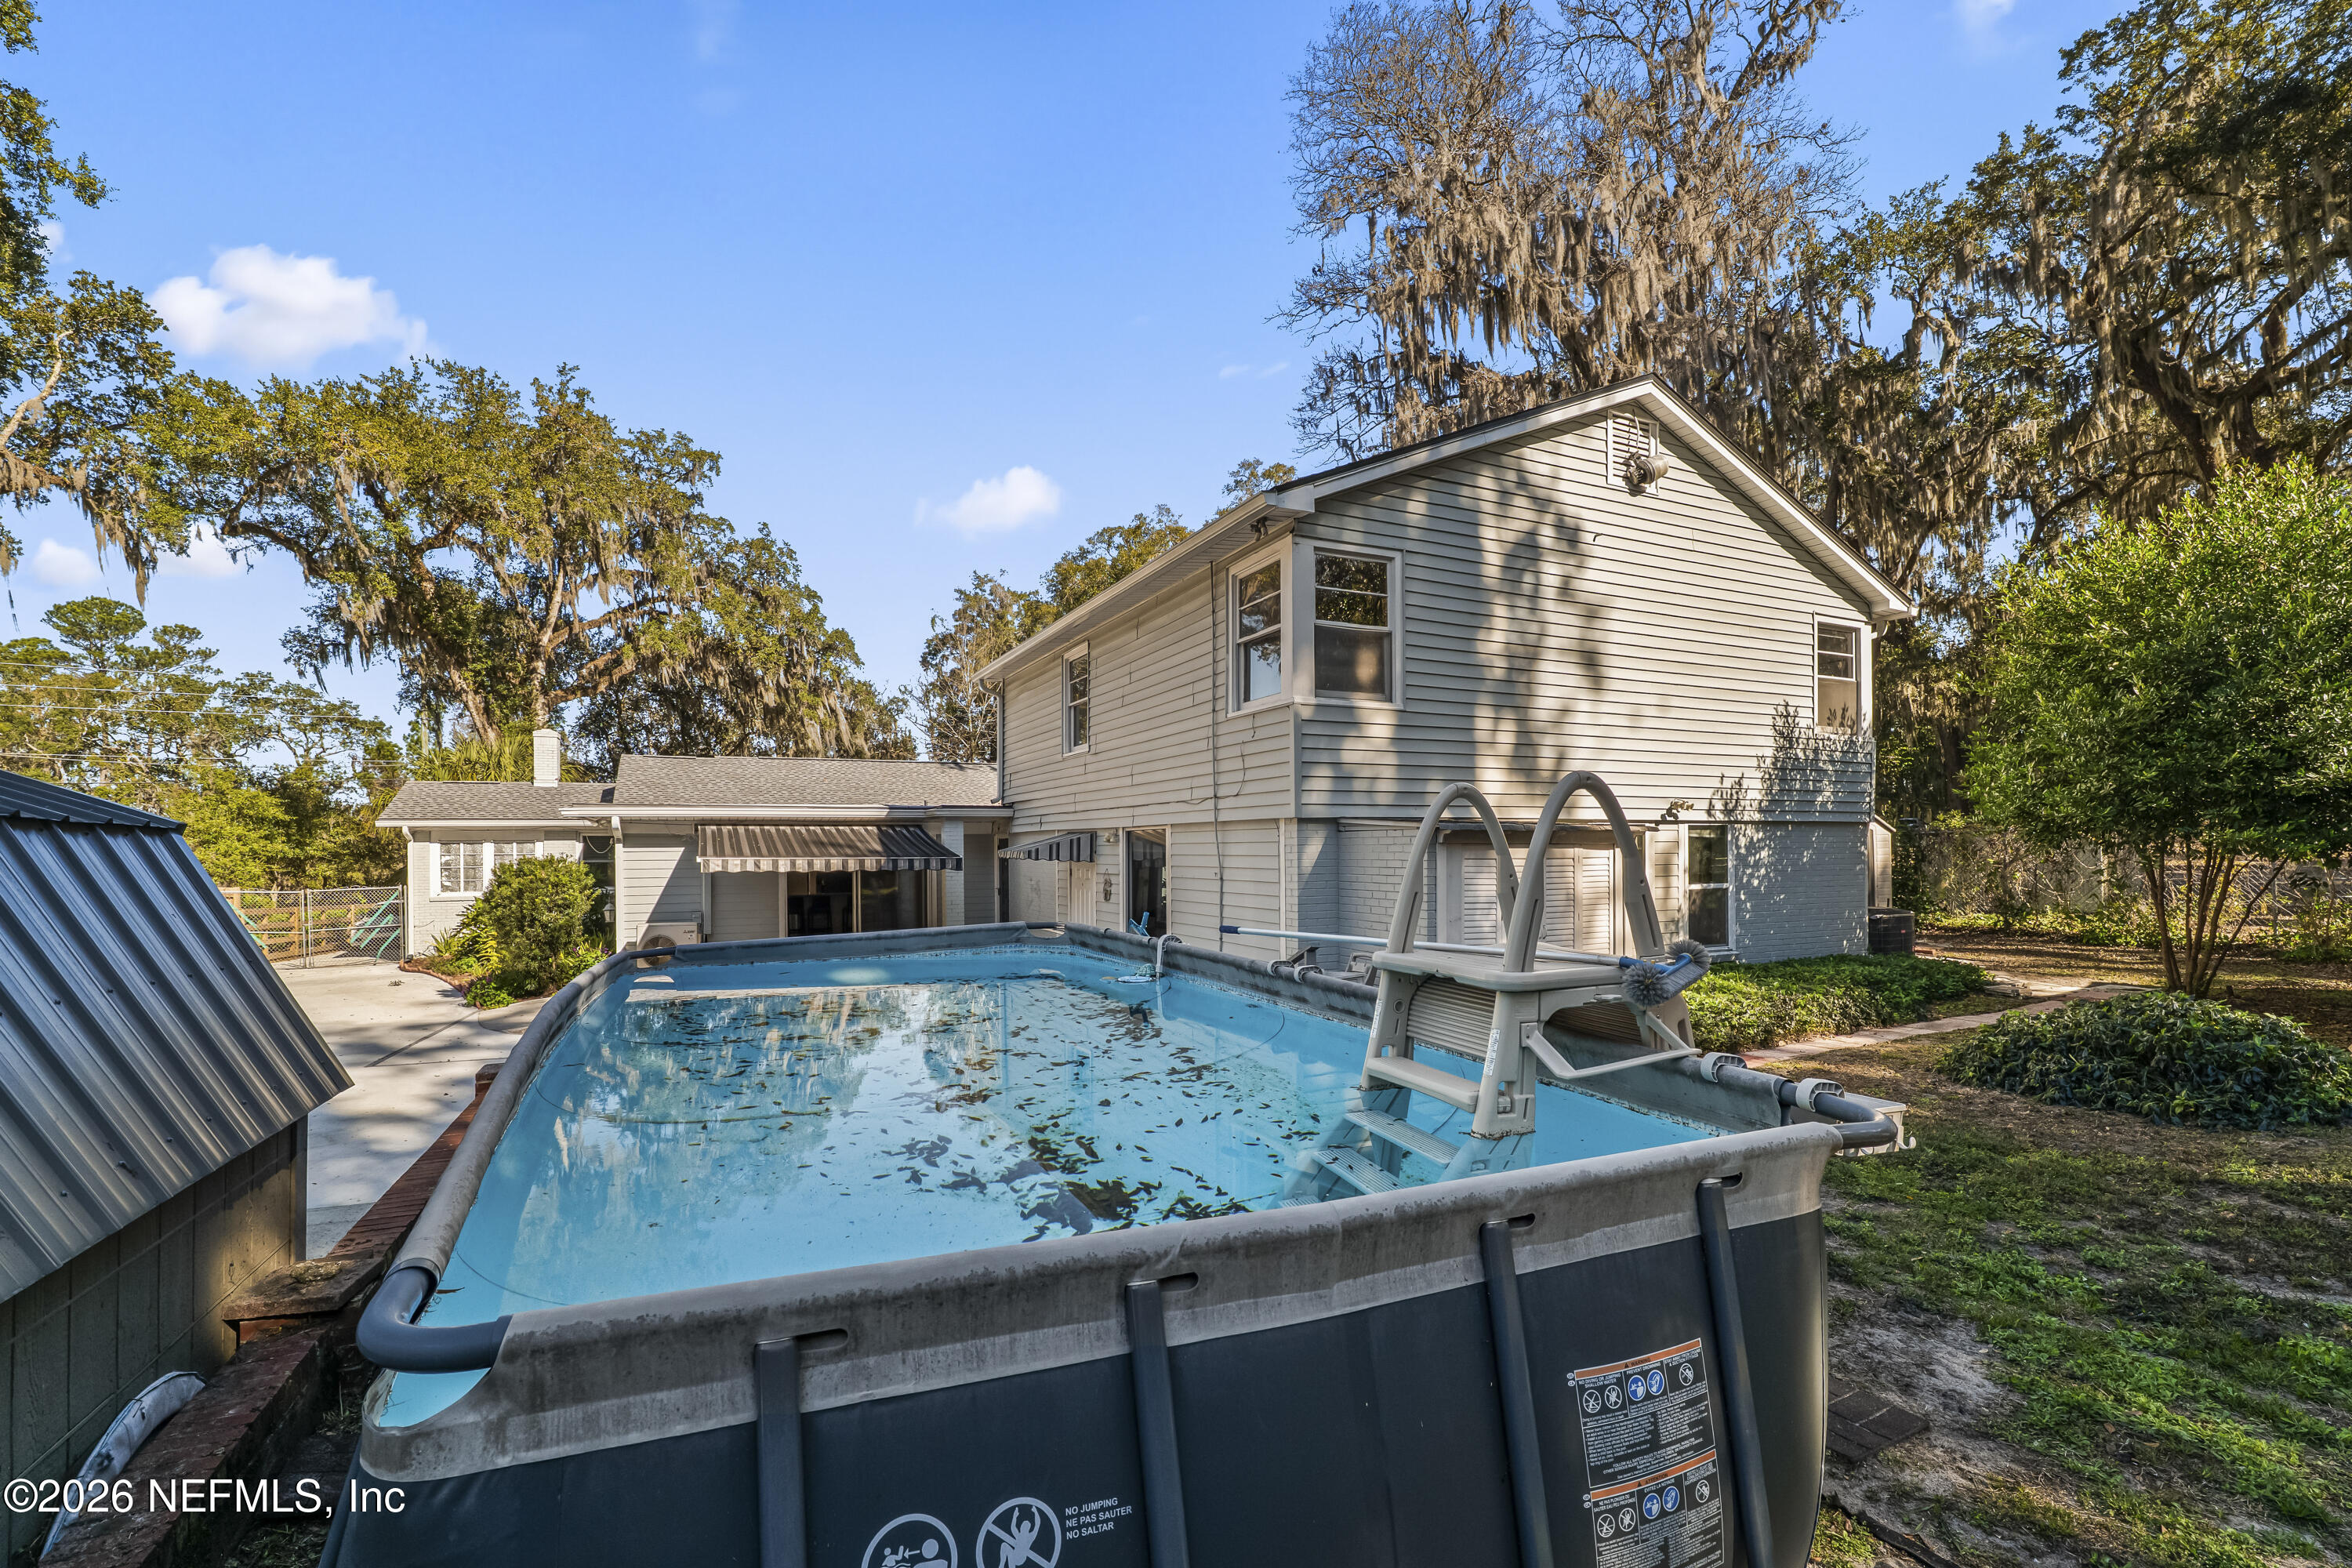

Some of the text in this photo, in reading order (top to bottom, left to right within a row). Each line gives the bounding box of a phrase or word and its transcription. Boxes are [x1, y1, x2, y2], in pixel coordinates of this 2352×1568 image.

[1631, 1357, 1651, 1367] WARNING
[1626, 1367, 1642, 1375] PREVENT
[1645, 1473, 1668, 1485] ATTENTION
[1065, 1497, 1118, 1516] NO JUMPING
[1065, 1505, 1132, 1528] NE PAS SAUTER
[1066, 1522, 1114, 1540] NO SALTAR
